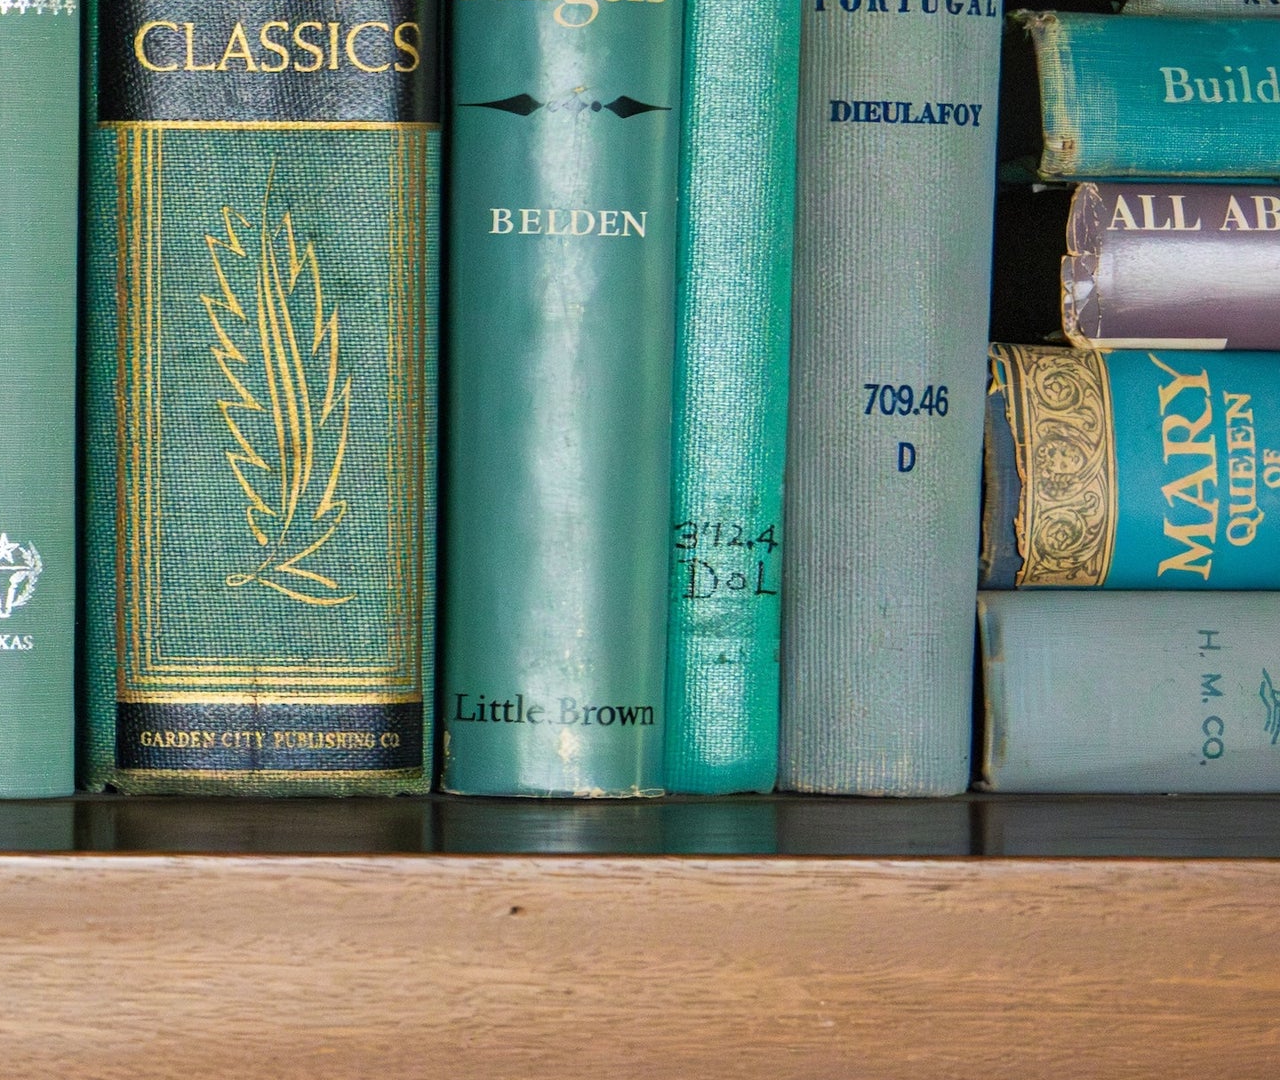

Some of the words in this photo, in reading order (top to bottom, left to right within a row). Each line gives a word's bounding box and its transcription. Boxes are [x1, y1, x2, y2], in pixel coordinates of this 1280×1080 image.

[134, 20, 422, 73] CLASSICS
[1159, 65, 1280, 104] Build
[829, 99, 983, 127] DIEULAFOY
[488, 208, 648, 238] BELDEN
[1106, 194, 1202, 231] ALL
[1219, 194, 1280, 231] AB
[864, 383, 949, 417] 709.46
[897, 441, 916, 473] D
[1147, 352, 1220, 581] MARY
[1223, 391, 1265, 546] QUEEN
[1197, 629, 1220, 658] H.
[1200, 673, 1225, 704] M.
[556, 696, 655, 727] Brown
[139, 730, 216, 749] GARDEN
[221, 731, 266, 749] CITY
[272, 731, 376, 749] PUBLISHING
